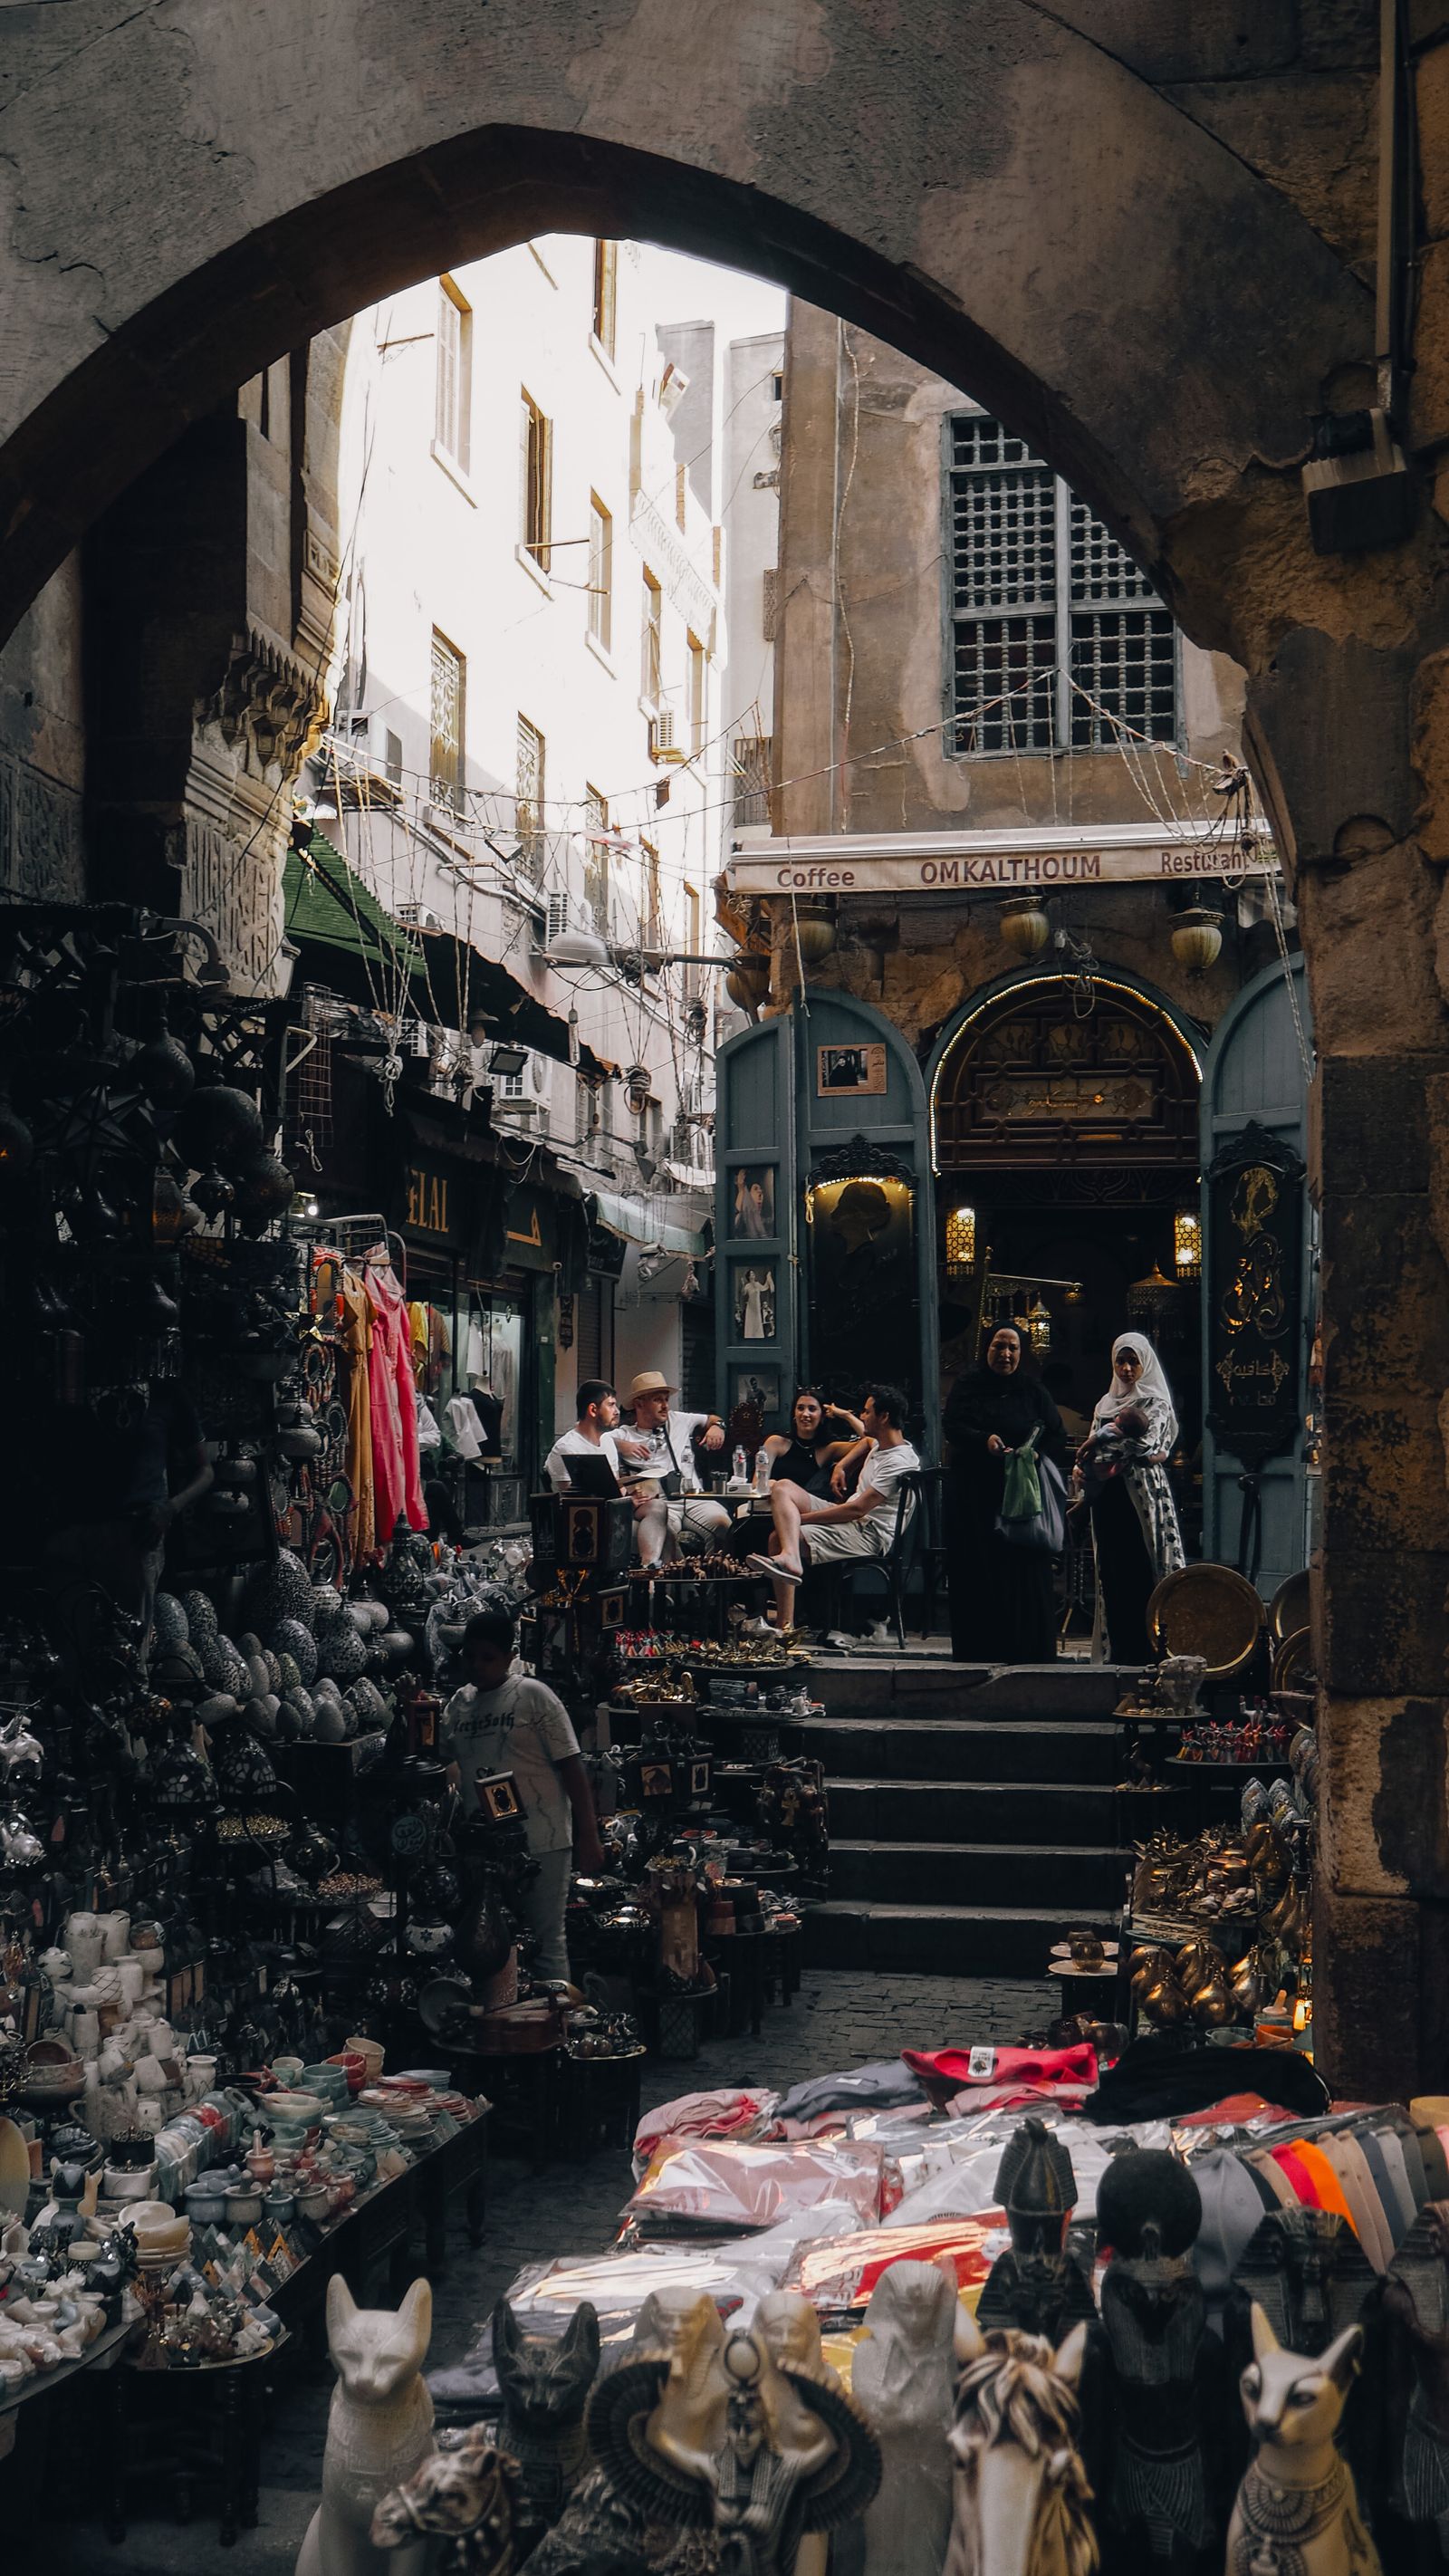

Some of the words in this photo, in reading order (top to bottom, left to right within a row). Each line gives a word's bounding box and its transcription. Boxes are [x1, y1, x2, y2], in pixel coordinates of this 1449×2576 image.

[776, 867, 856, 889] Coffee
[920, 855, 1101, 885] OMKALTHOUM
[1160, 851, 1250, 875] Resturan
